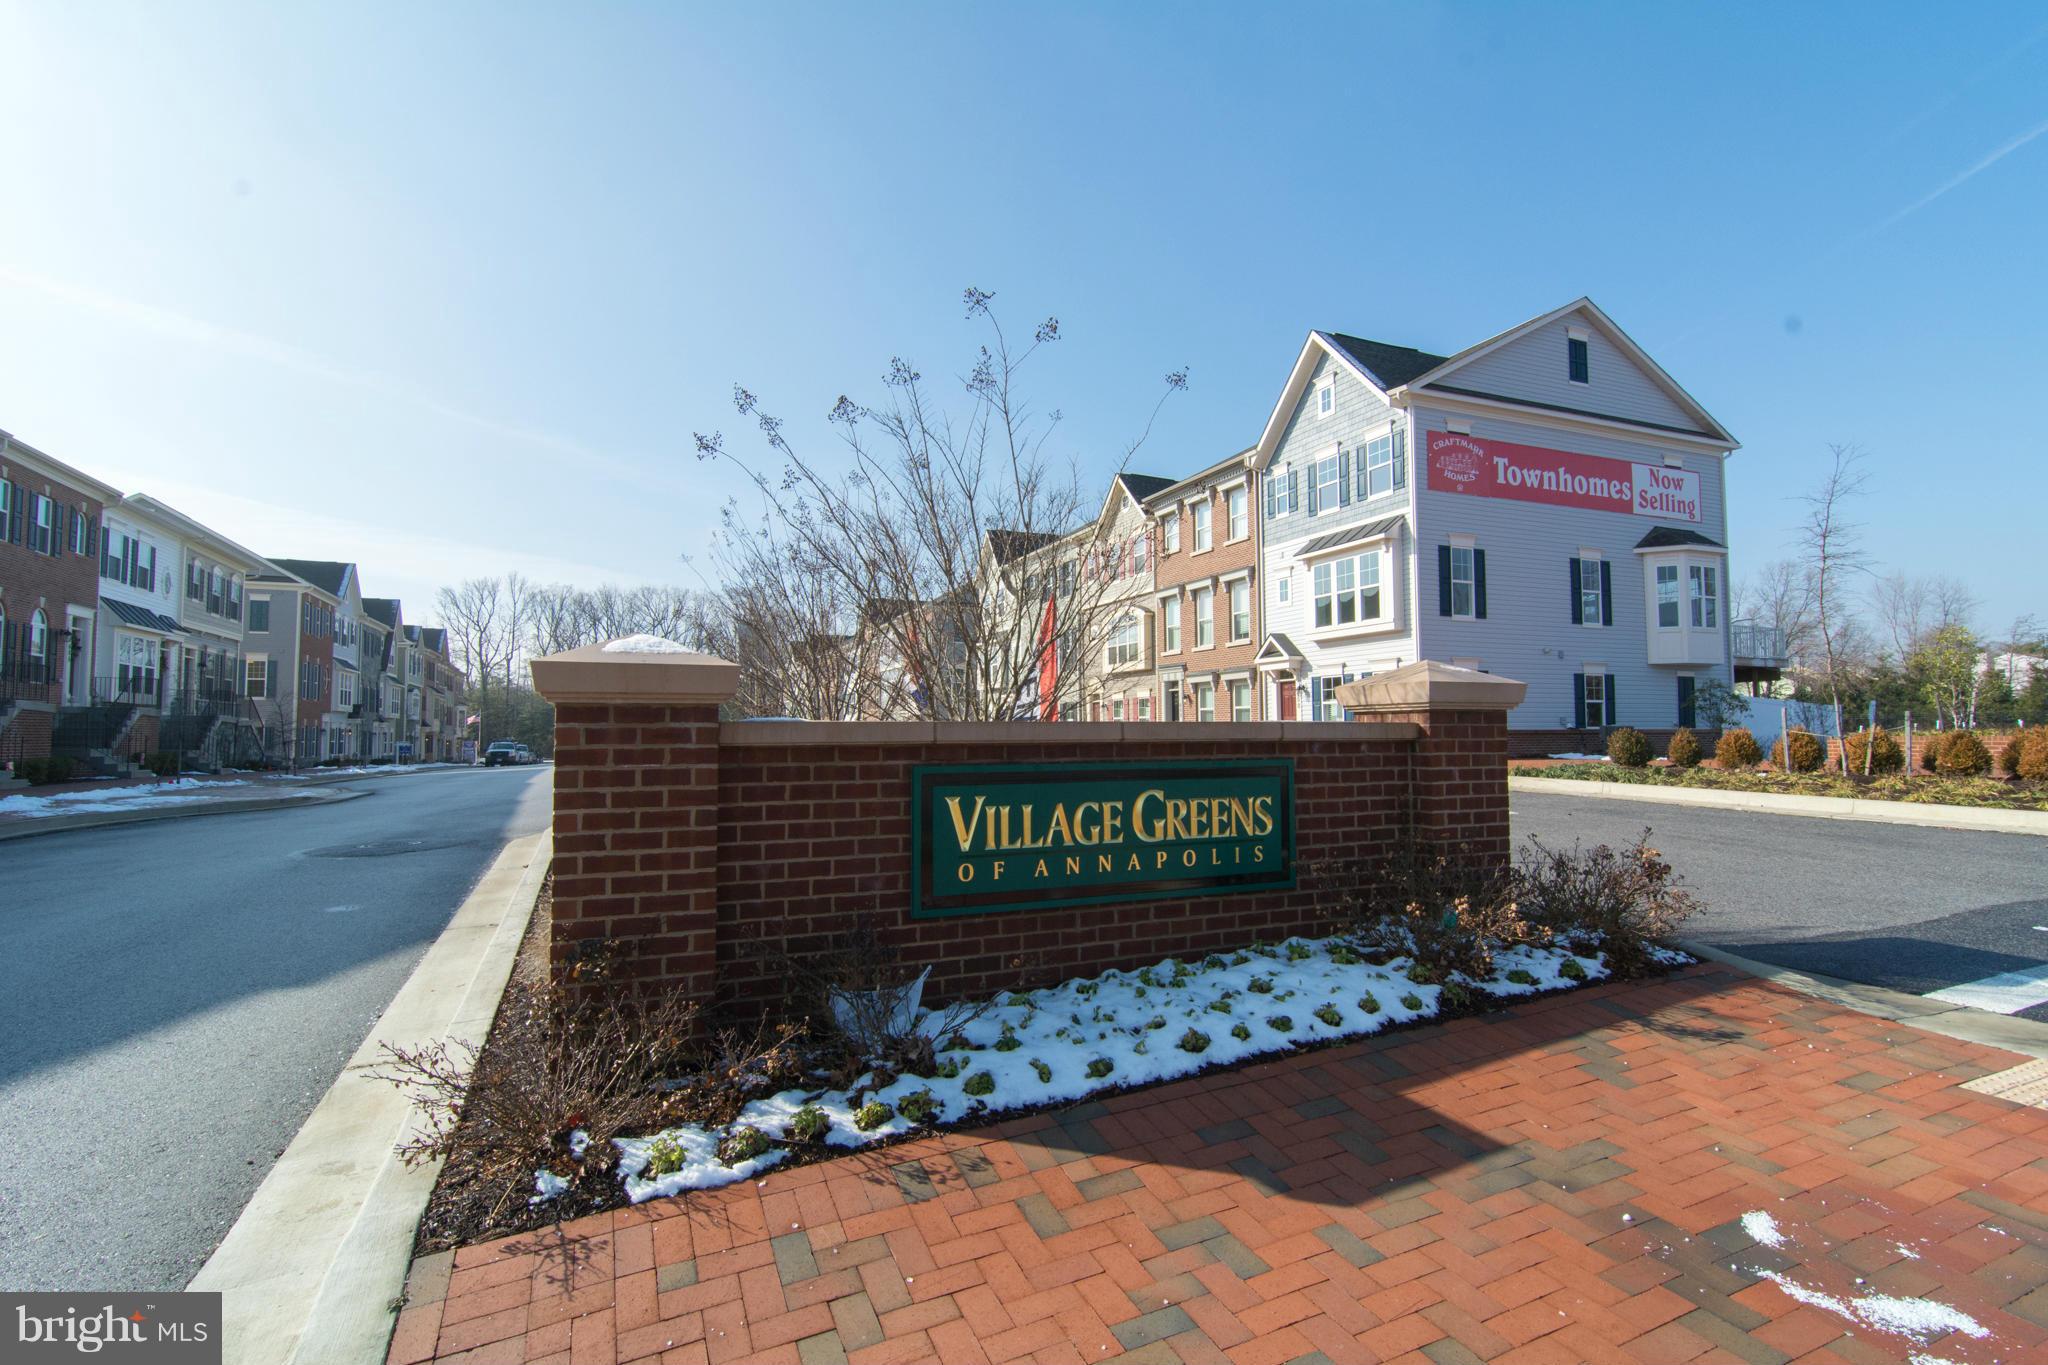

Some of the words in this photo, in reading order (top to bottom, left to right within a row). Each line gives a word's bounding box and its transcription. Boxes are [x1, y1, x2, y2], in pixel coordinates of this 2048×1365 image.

[1444, 469, 1477, 482] HOMES
[1493, 456, 1632, 501] Townhomes
[1648, 467, 1685, 491] Now
[1638, 489, 1696, 520] Selling
[945, 795, 1124, 853] VILLAGE
[1132, 789, 1274, 843] GREENS
[958, 860, 1006, 882] OF
[1034, 845, 1265, 878] ANNAPOLIS
